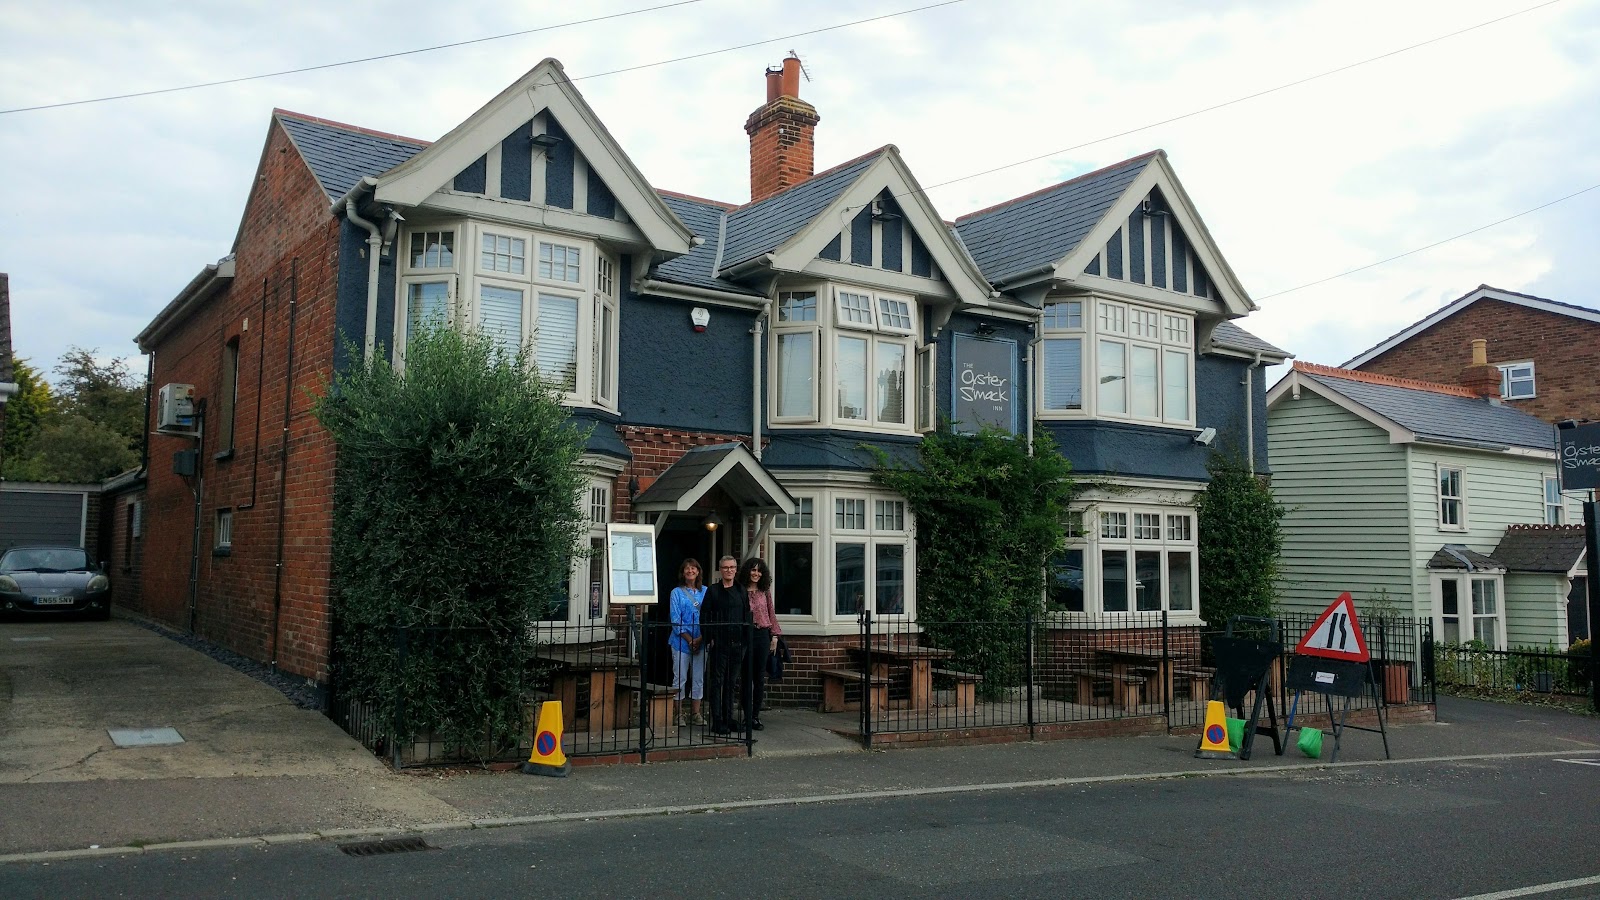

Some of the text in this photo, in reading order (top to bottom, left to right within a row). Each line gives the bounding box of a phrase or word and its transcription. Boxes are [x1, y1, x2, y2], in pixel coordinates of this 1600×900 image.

[961, 369, 1007, 388] Oyster
[959, 386, 1008, 402] Smack
[1564, 444, 1600, 461] Oyste
[1563, 456, 1600, 468] Smac
